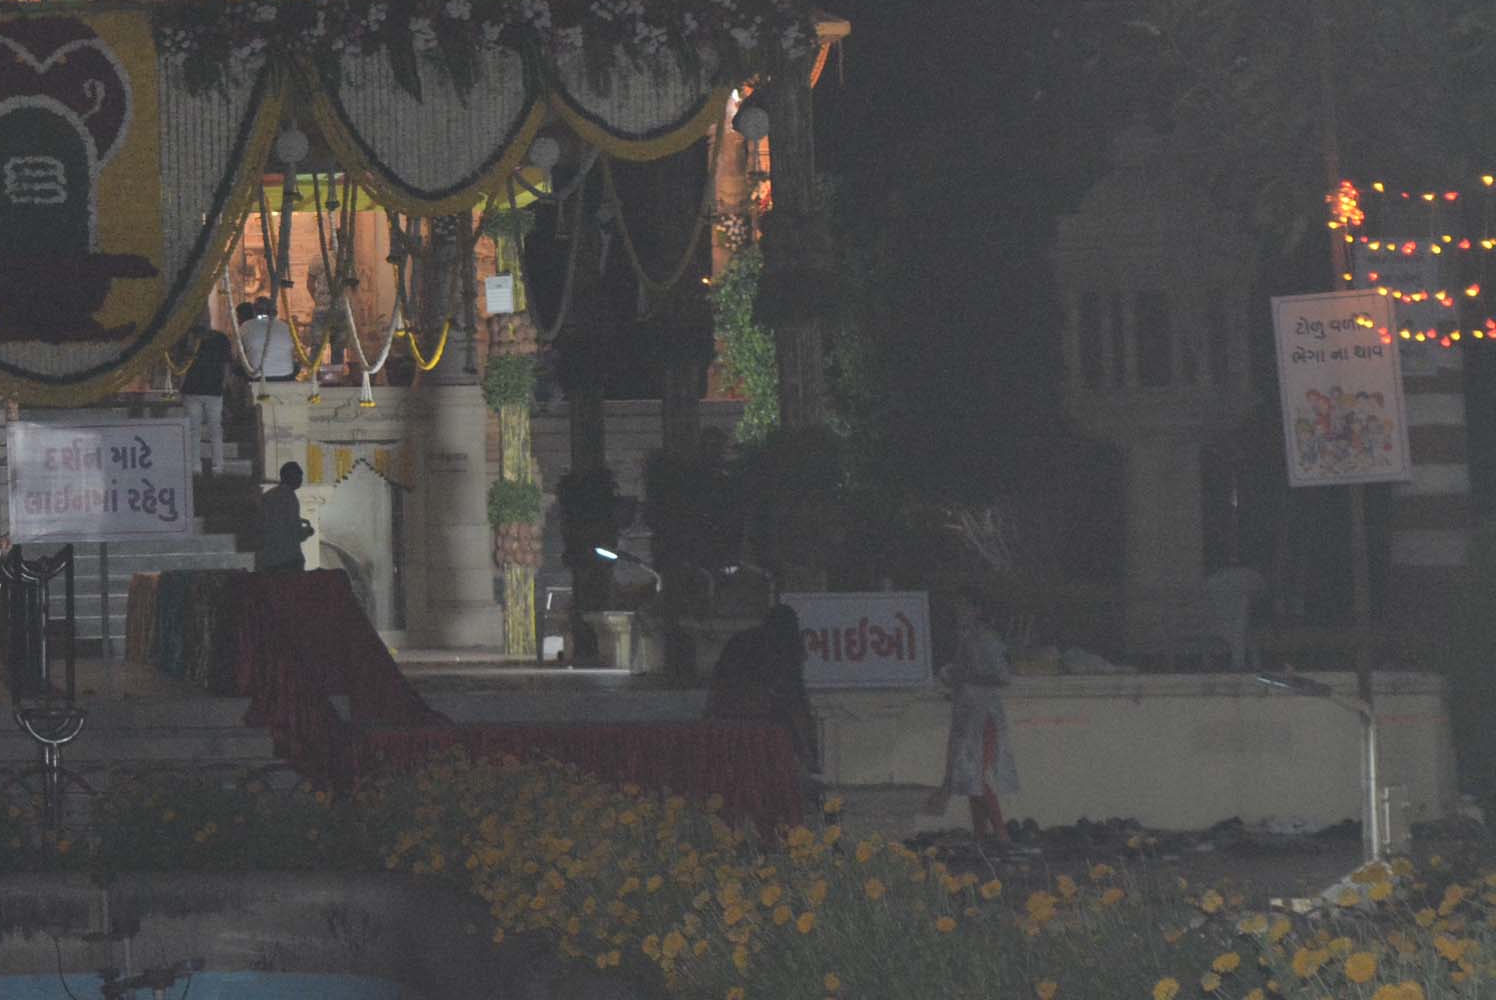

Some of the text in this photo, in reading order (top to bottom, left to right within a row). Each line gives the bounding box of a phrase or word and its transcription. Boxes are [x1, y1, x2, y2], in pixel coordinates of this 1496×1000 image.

[1292, 346, 1325, 363] ભેગા
[1330, 347, 1349, 361] ના
[44, 435, 153, 472] દર્શન માટે
[127, 478, 178, 522] રહેવુ
